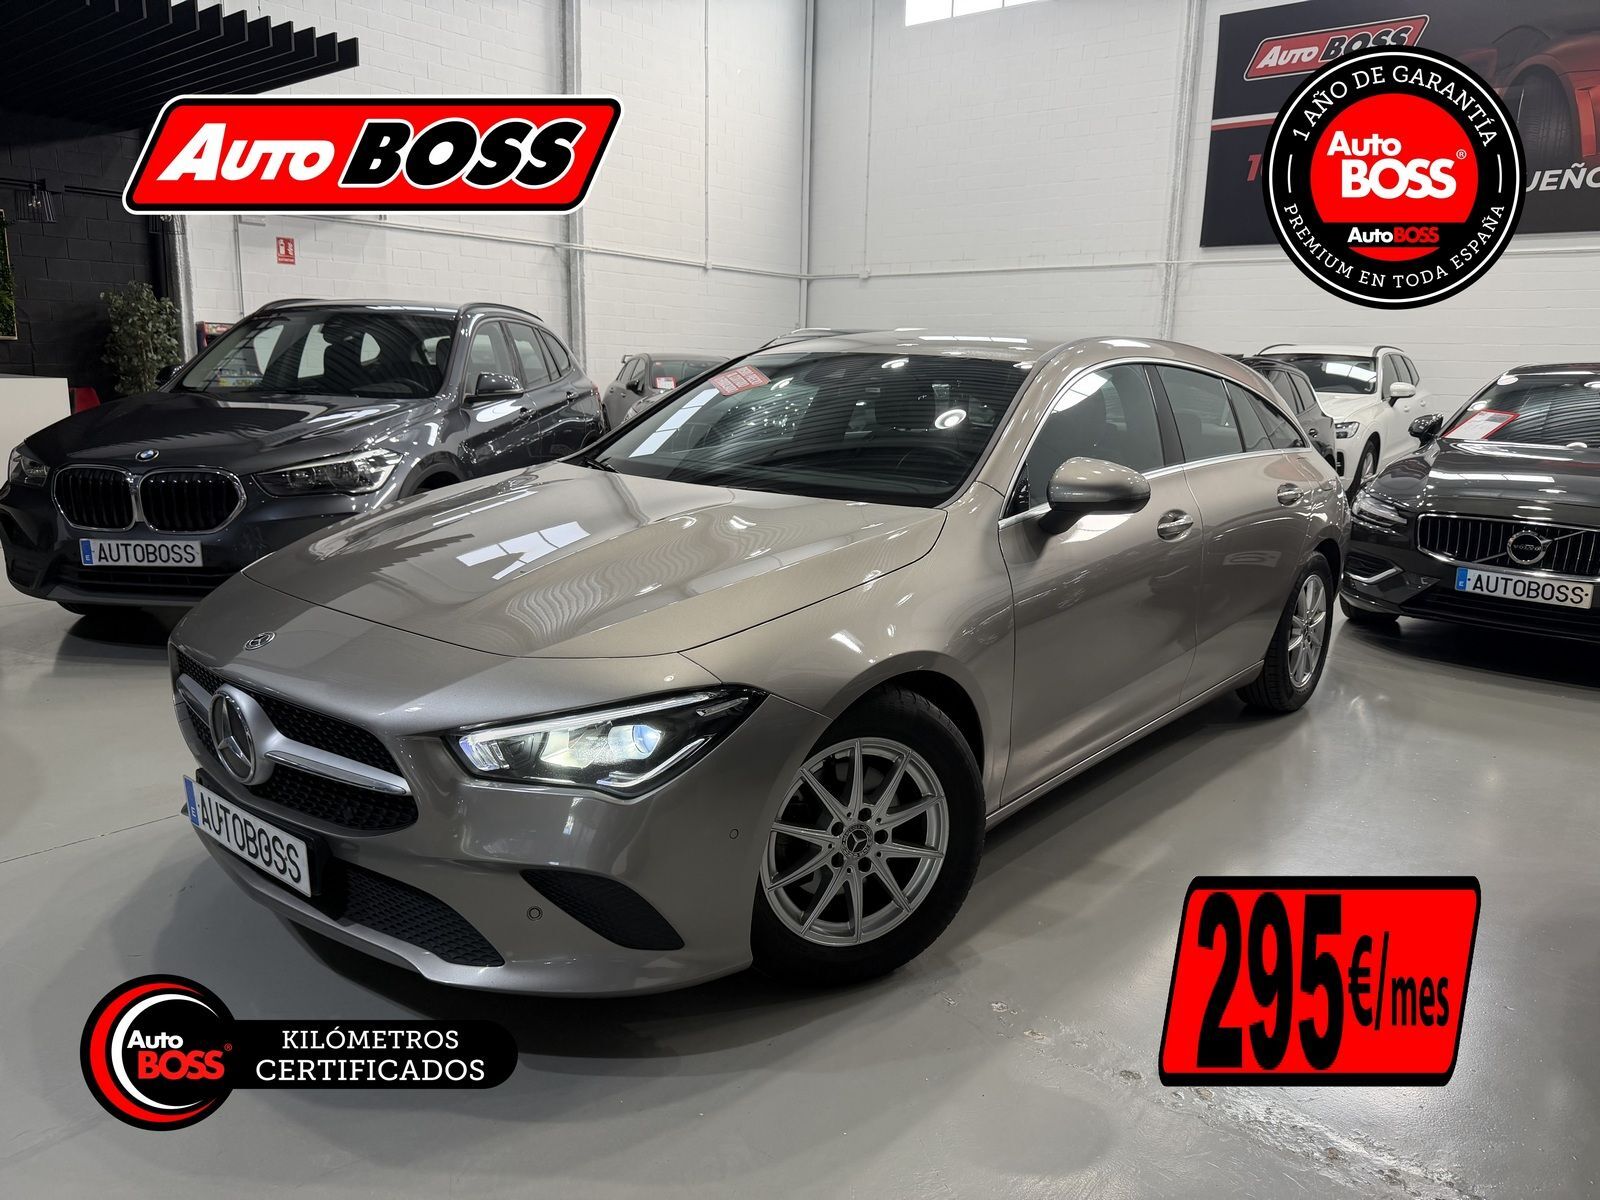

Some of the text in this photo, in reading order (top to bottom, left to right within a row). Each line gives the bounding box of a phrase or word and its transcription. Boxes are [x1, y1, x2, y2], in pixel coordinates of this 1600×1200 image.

[98, 542, 197, 564] AUTOBOSS
[1472, 573, 1585, 605] AUTOBOSS
[200, 791, 302, 884] AUTOBOSS
